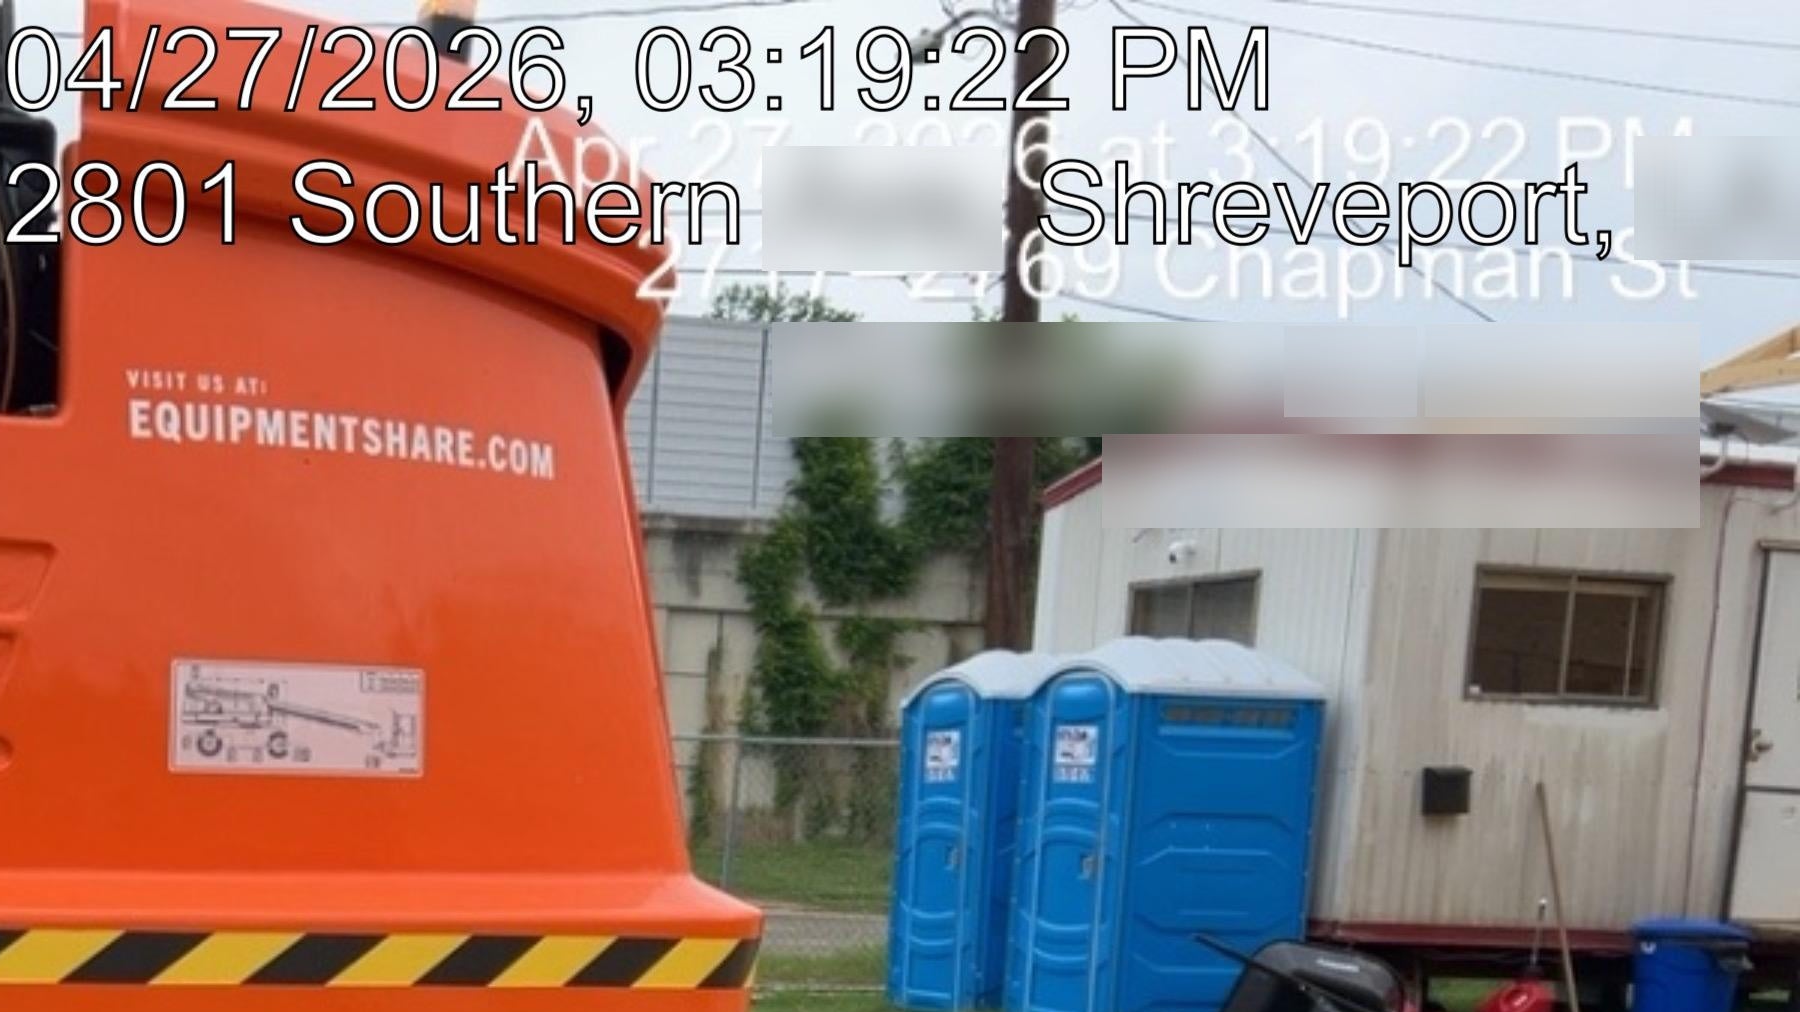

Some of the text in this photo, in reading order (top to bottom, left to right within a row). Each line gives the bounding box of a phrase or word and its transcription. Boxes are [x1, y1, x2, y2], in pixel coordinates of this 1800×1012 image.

[126, 370, 187, 391] VISIT
[197, 375, 225, 393] US
[128, 398, 556, 480] EQUIPMENTSHARE.COM
